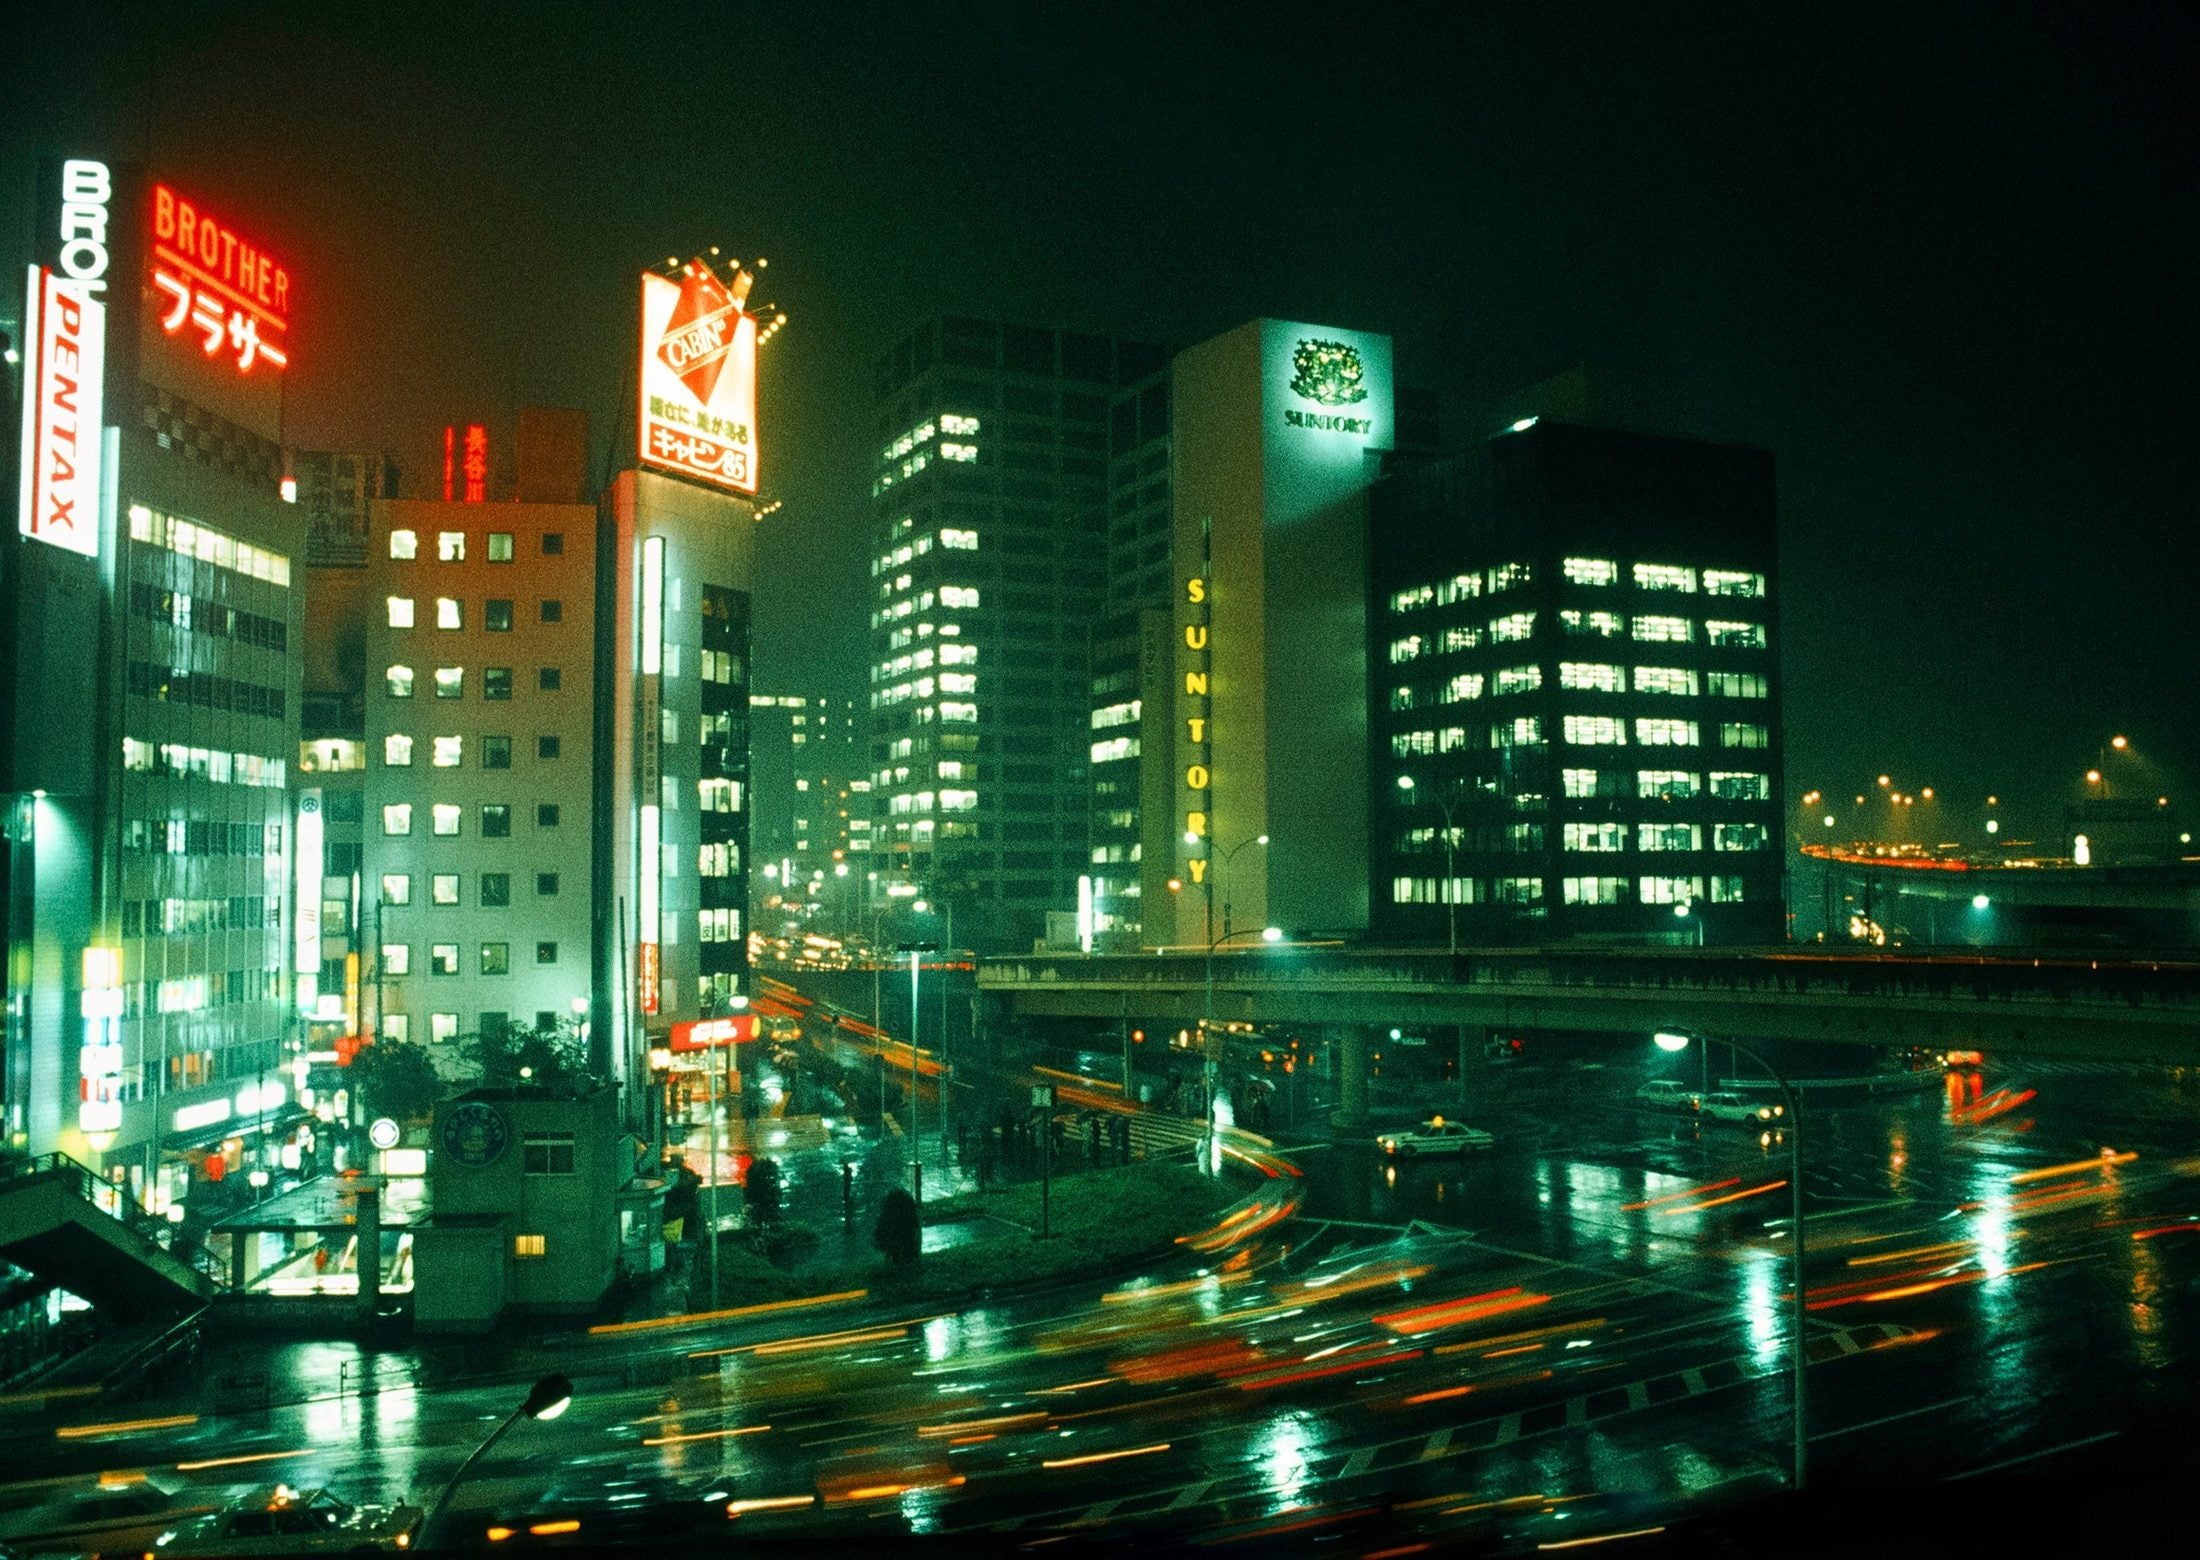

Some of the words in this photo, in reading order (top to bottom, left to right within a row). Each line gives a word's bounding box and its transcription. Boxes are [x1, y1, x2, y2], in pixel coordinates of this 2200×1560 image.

[154, 184, 290, 312] BROTHER
[666, 324, 723, 368] CABIN
[48, 291, 82, 532] PENTAX
[1284, 409, 1373, 434] SUNTORY
[1185, 578, 1208, 884] SUNTORY
